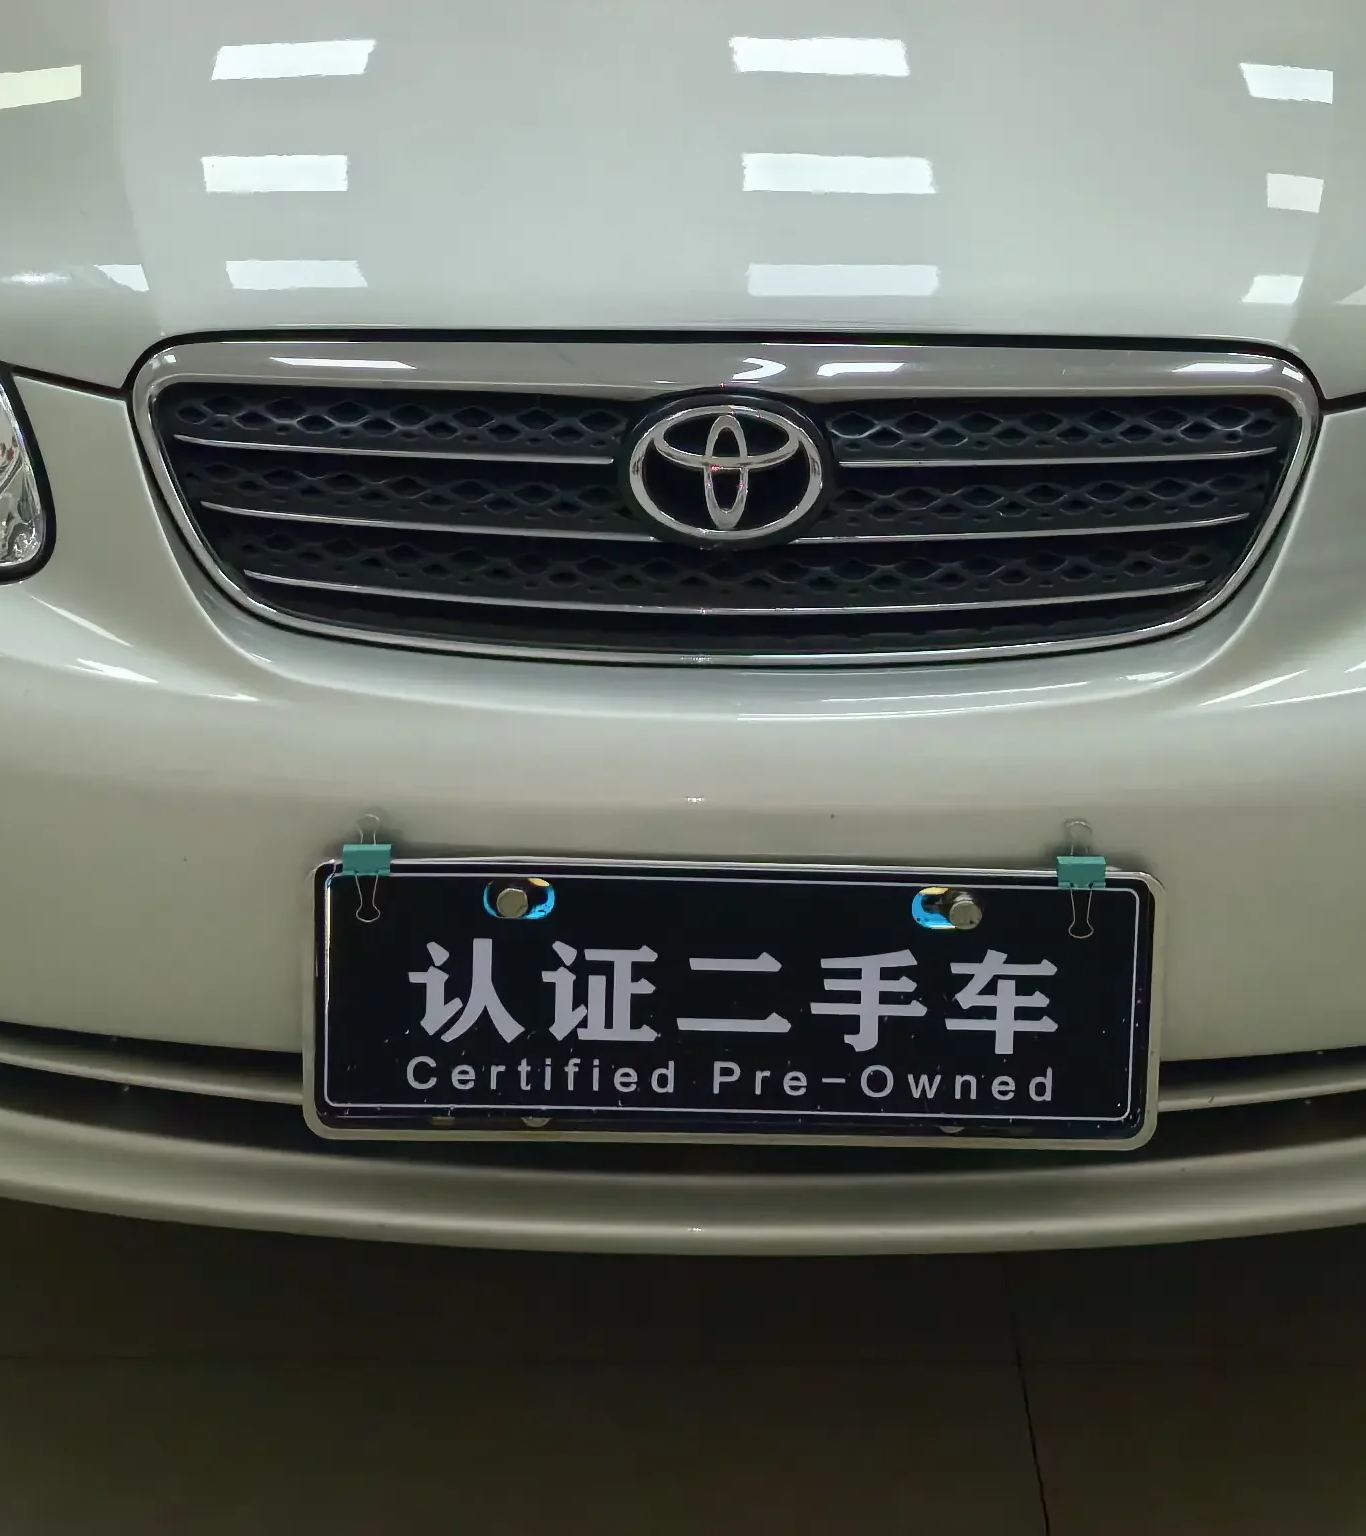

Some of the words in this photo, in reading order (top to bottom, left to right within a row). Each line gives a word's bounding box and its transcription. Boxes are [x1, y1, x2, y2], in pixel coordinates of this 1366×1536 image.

[408, 938, 1059, 1054] 认证二手车
[406, 1055, 675, 1094] Certified
[712, 1060, 1052, 1102] Pre-Owned
